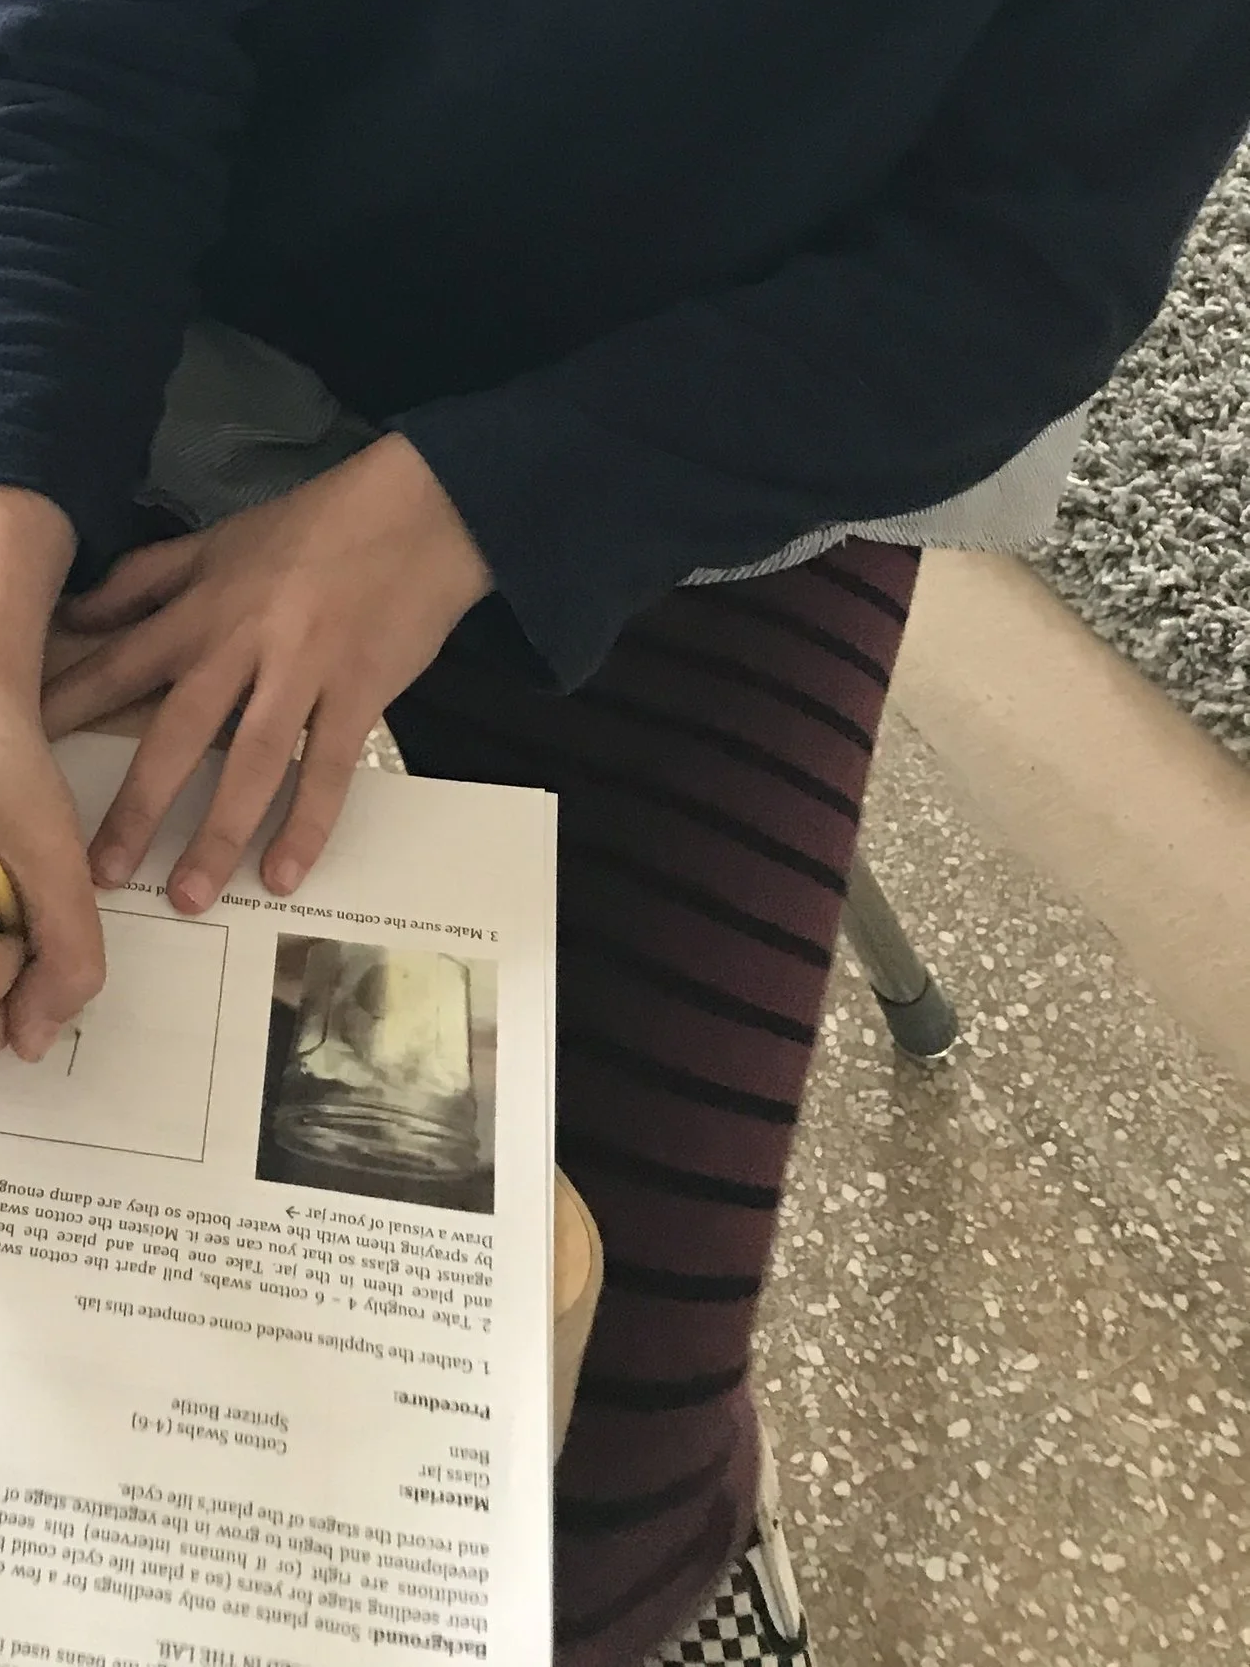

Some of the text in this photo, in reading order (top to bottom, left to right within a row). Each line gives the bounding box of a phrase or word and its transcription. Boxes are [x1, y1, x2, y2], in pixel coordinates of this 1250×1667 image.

[121, 881, 152, 893] reco
[221, 893, 261, 911] damp
[264, 901, 288, 912] are
[290, 905, 333, 918] swabs
[337, 911, 381, 925] cotton
[384, 917, 406, 930] the
[410, 920, 442, 932] sure
[444, 925, 483, 940] Make
[50, 1188, 93, 1208] damp
[97, 1197, 122, 1210] are
[35, 1208, 84, 1224] cotton
[126, 1199, 160, 1218] they
[164, 1207, 182, 1219] so
[88, 1216, 112, 1232] the
[186, 1210, 232, 1230] bottle
[236, 1218, 282, 1234] water
[305, 1208, 493, 1250] Draw a visual of your jar
[24, 1226, 48, 1242] the
[56, 1231, 98, 1248] place
[119, 1220, 179, 1242] Moisten
[186, 1230, 199, 1244] it.
[204, 1233, 230, 1246] see
[287, 1225, 311, 1241] the
[317, 1230, 351, 1245] with
[105, 1239, 135, 1252] and
[143, 1243, 179, 1263] bean
[236, 1238, 263, 1250] can
[268, 1242, 298, 1257] you
[356, 1236, 396, 1255] them
[400, 1241, 468, 1263] spraying
[30, 1247, 78, 1264] cotton
[84, 1255, 109, 1271] the
[188, 1251, 217, 1264] one
[302, 1248, 333, 1265] that
[338, 1254, 356, 1266] so
[474, 1252, 493, 1271] by
[115, 1260, 157, 1275] apart
[163, 1267, 193, 1282] pull
[226, 1257, 264, 1275] Take
[273, 1263, 298, 1279] jar.
[361, 1258, 400, 1275] glass
[405, 1265, 431, 1281] the
[200, 1272, 252, 1291] swabs,
[306, 1269, 330, 1285] the
[340, 1274, 354, 1289] in
[437, 1270, 493, 1287] against
[260, 1282, 308, 1299] cotton
[364, 1278, 403, 1297] them
[412, 1287, 454, 1305] place
[75, 1296, 101, 1313] lab.
[315, 1292, 325, 1305] 6
[349, 1297, 357, 1311] 4
[464, 1294, 493, 1310] and
[106, 1301, 134, 1317] this
[138, 1306, 206, 1326] compete
[364, 1297, 425, 1319] roughly
[209, 1317, 252, 1333] come
[432, 1311, 472, 1331] Take
[256, 1324, 313, 1343] needed
[318, 1335, 384, 1359] Supplies
[388, 1347, 414, 1364] the
[420, 1352, 473, 1374] Gather
[171, 1399, 289, 1432] Spritzer Bottle
[132, 1412, 288, 1455] Cotton Swabs (4-6)
[449, 1446, 490, 1467] Bean
[418, 1465, 491, 1488] Glass Jar
[167, 1492, 193, 1511] life
[198, 1497, 254, 1520] plant's
[258, 1507, 284, 1526] the
[287, 1514, 305, 1529] of
[309, 1517, 360, 1538] stages
[365, 1527, 392, 1546] the
[11, 1538, 57, 1557] could
[396, 1533, 452, 1553] record
[458, 1541, 490, 1558] and
[62, 1548, 104, 1566] cycle
[108, 1556, 135, 1575] life
[11, 1565, 42, 1585] few
[49, 1570, 58, 1583] a
[141, 1561, 185, 1583] plant
[191, 1569, 200, 1583] a
[63, 1573, 88, 1592] for
[94, 1577, 172, 1603] seedlings
[205, 1572, 232, 1592] (so
[237, 1578, 284, 1598] years
[178, 1590, 216, 1612] only
[288, 1587, 314, 1608] for
[318, 1592, 362, 1614] stage
[222, 1600, 251, 1618] are
[256, 1606, 309, 1630] plants
[368, 1598, 440, 1625] seedling
[314, 1616, 361, 1643] Some
[446, 1615, 488, 1634] their
